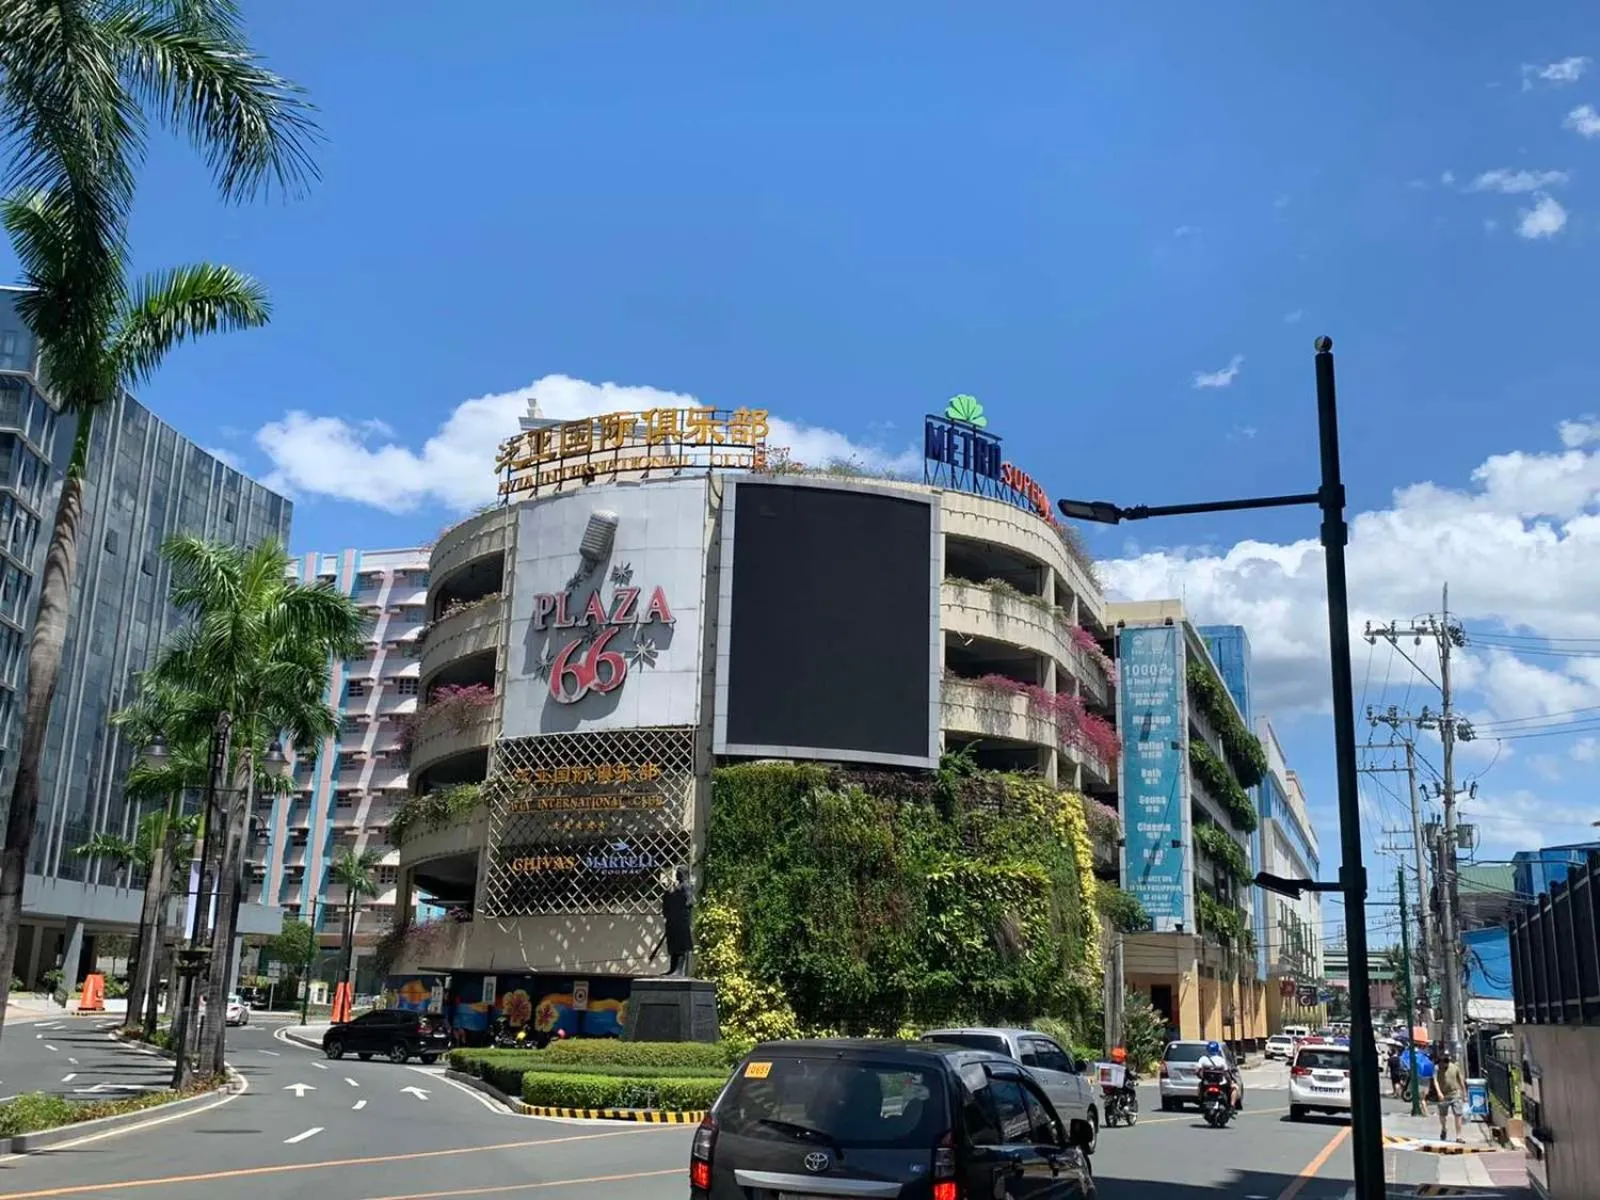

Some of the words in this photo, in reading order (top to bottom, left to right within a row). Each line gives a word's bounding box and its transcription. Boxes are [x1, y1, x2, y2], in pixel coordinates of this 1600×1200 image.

[533, 584, 676, 631] PLAZA
[549, 626, 628, 704] 66
[538, 795, 623, 810] INTERNATIONAL
[512, 854, 575, 872] CHIVAS
[586, 855, 657, 869] MARTELL
[1311, 1085, 1345, 1093] SECURITY
